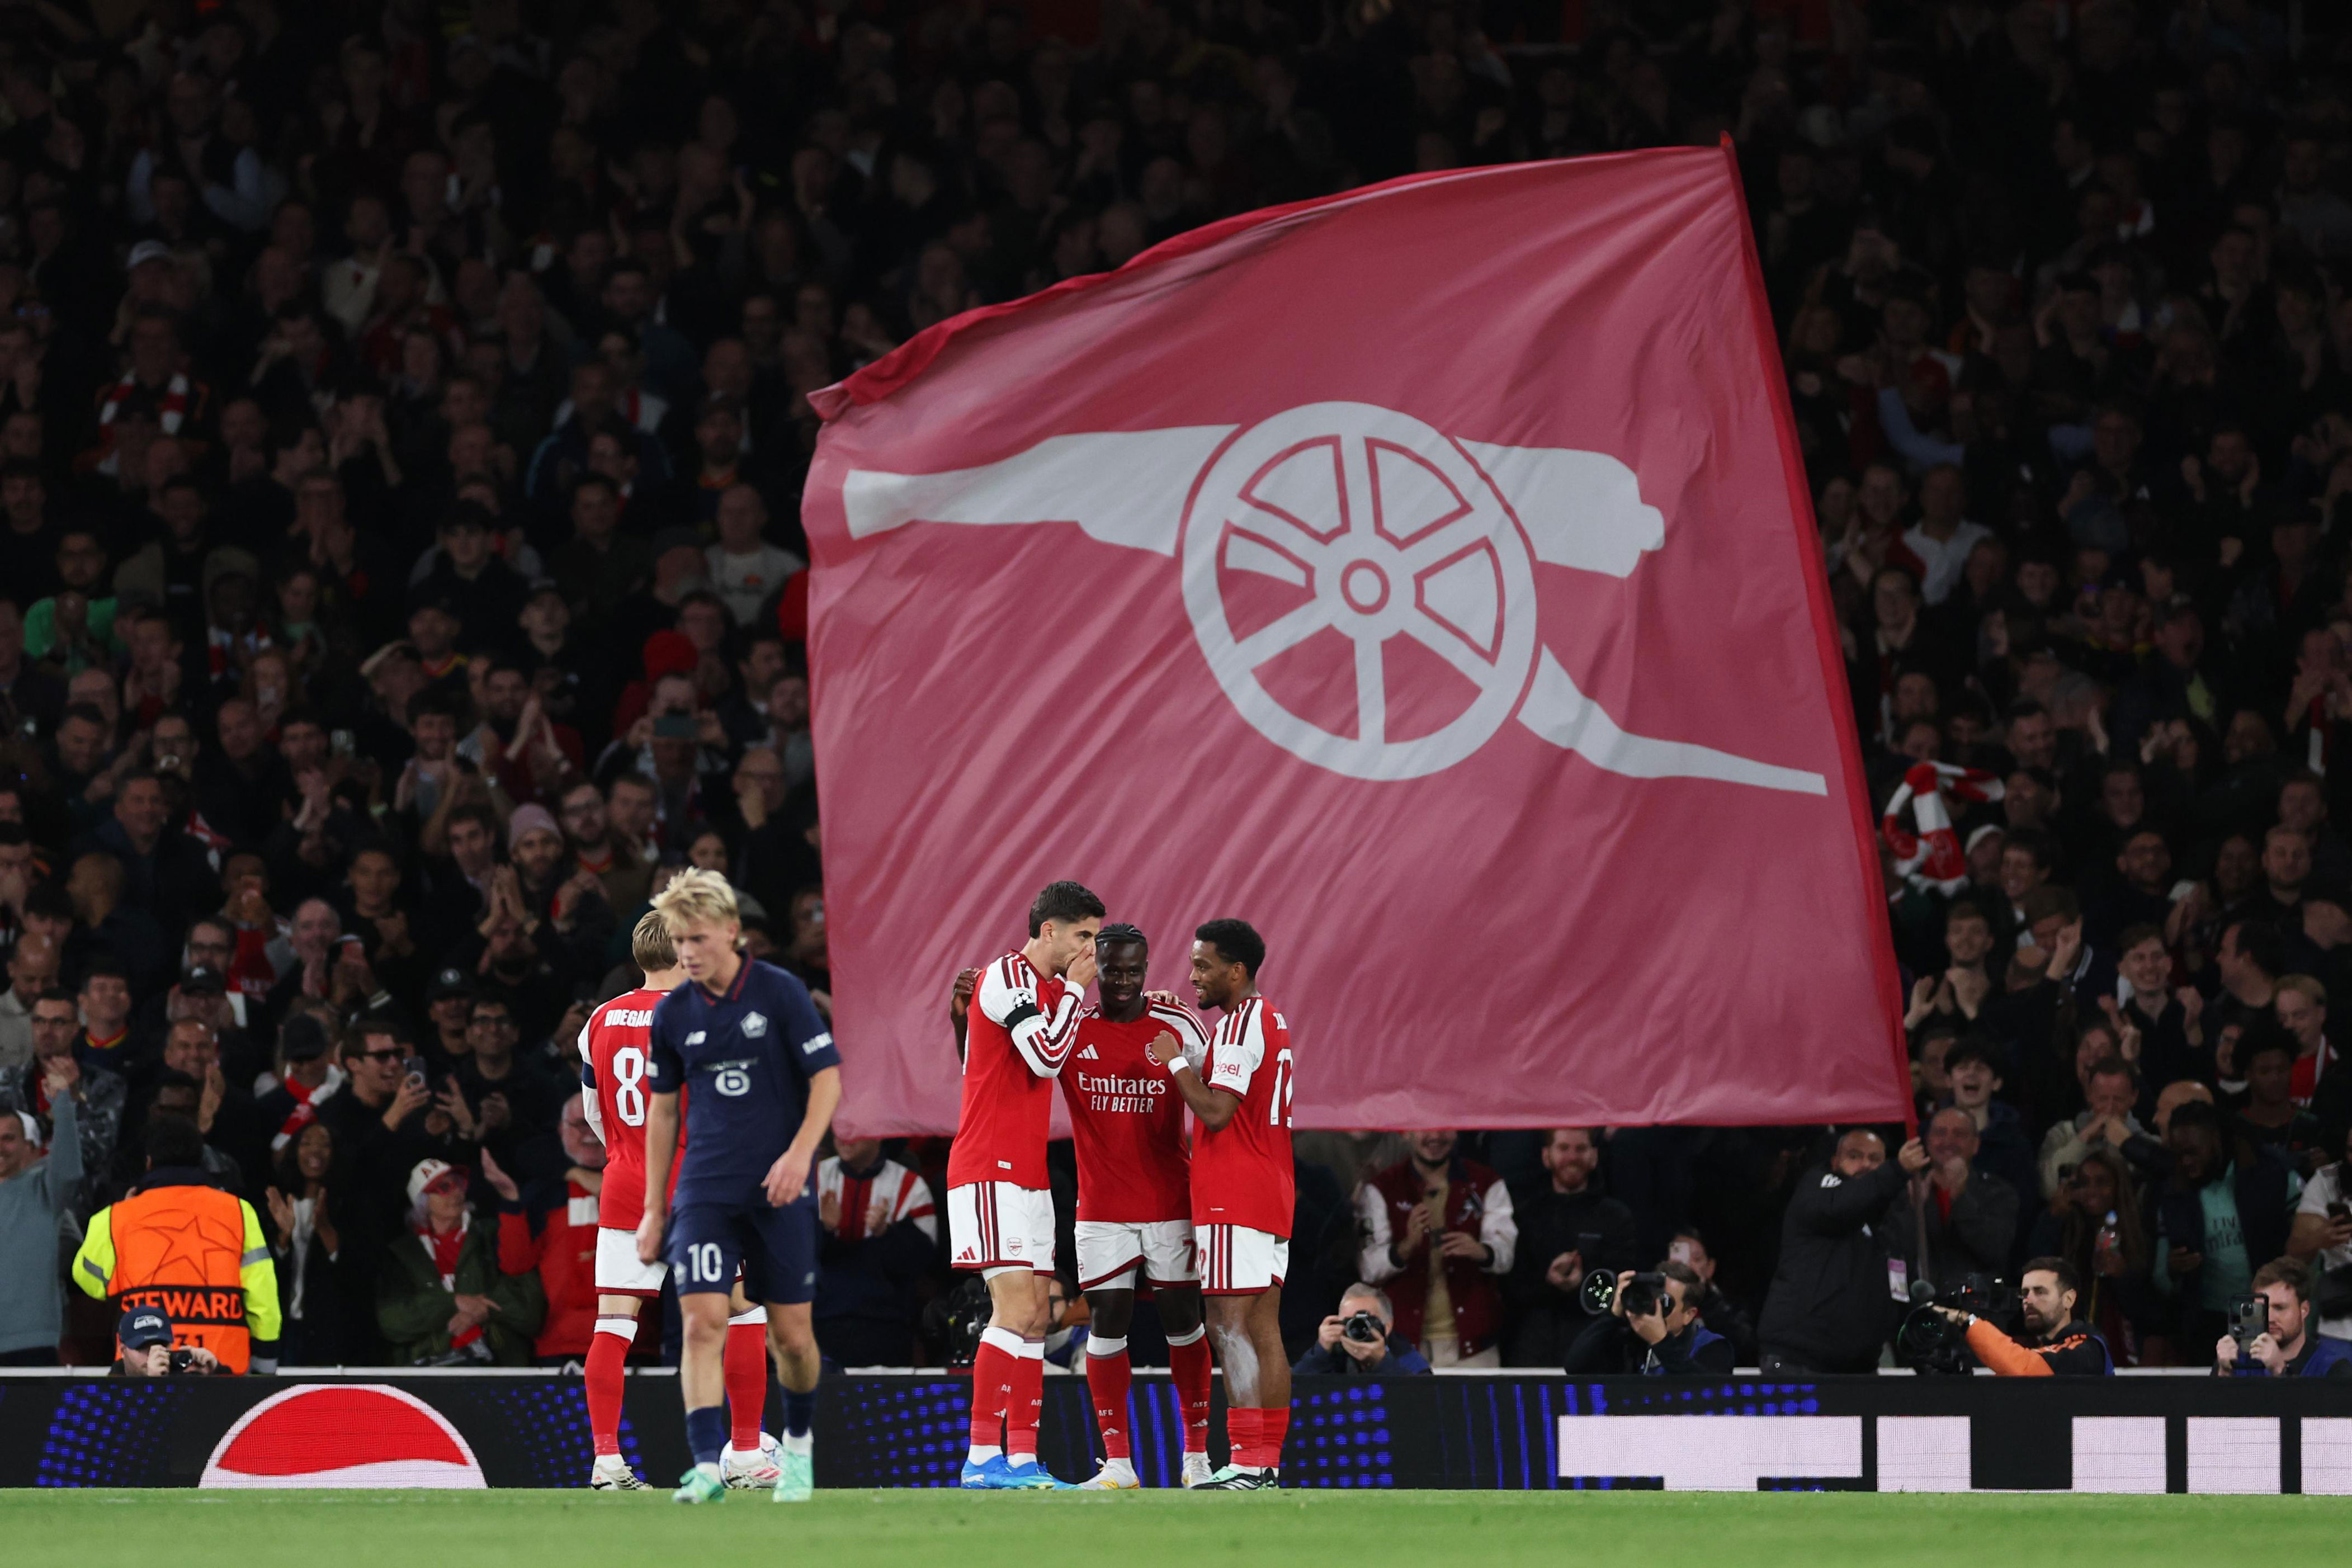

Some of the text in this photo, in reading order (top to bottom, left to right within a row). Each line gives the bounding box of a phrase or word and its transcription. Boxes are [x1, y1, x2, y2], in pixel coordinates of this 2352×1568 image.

[1078, 1071, 1166, 1095] Emirates
[1214, 1061, 1241, 1078] deel.
[613, 1047, 645, 1126] 8
[1091, 1095, 1154, 1113] FLY BETTER
[687, 1242, 723, 1282] 10
[1183, 1239, 1197, 1273] 7
[121, 1291, 243, 1319] STEWARD
